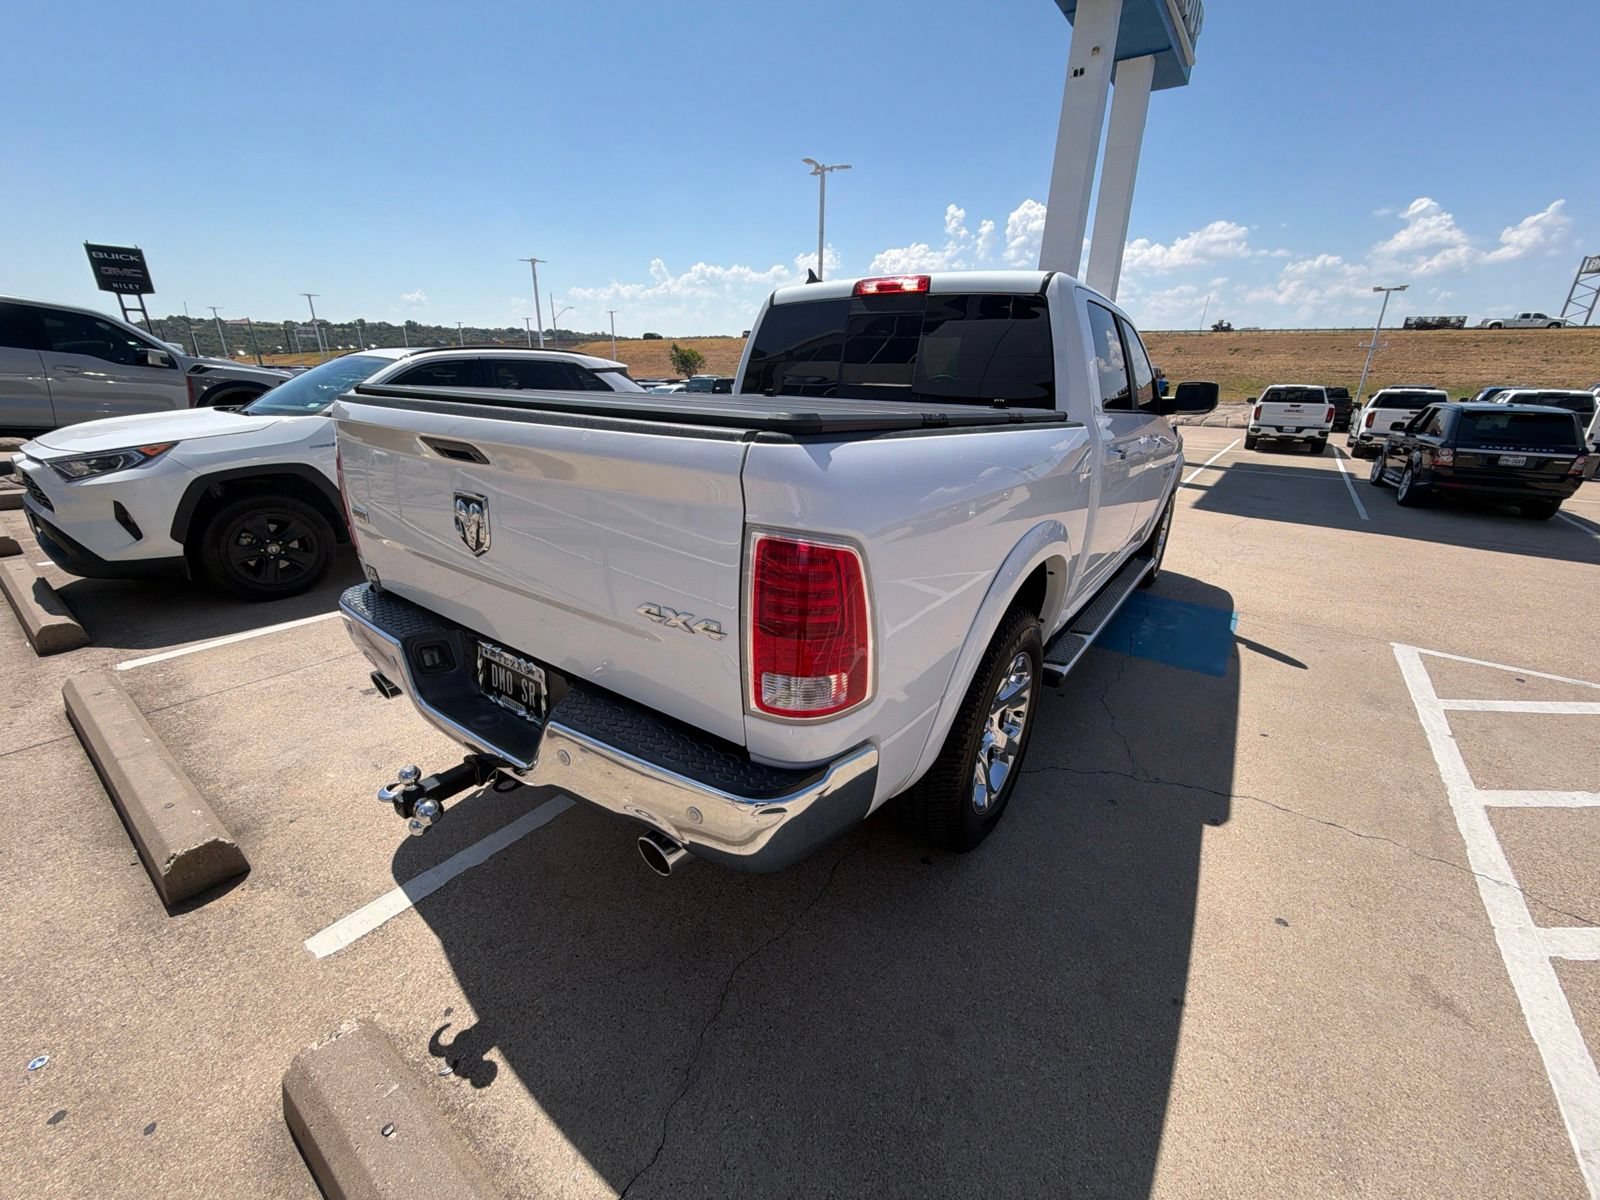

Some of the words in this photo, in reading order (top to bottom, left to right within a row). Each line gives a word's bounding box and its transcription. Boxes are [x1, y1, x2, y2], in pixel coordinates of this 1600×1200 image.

[91, 251, 140, 261] BUICK
[100, 266, 143, 278] GMC
[112, 282, 140, 290] HILEY
[521, 678, 536, 708] SR
